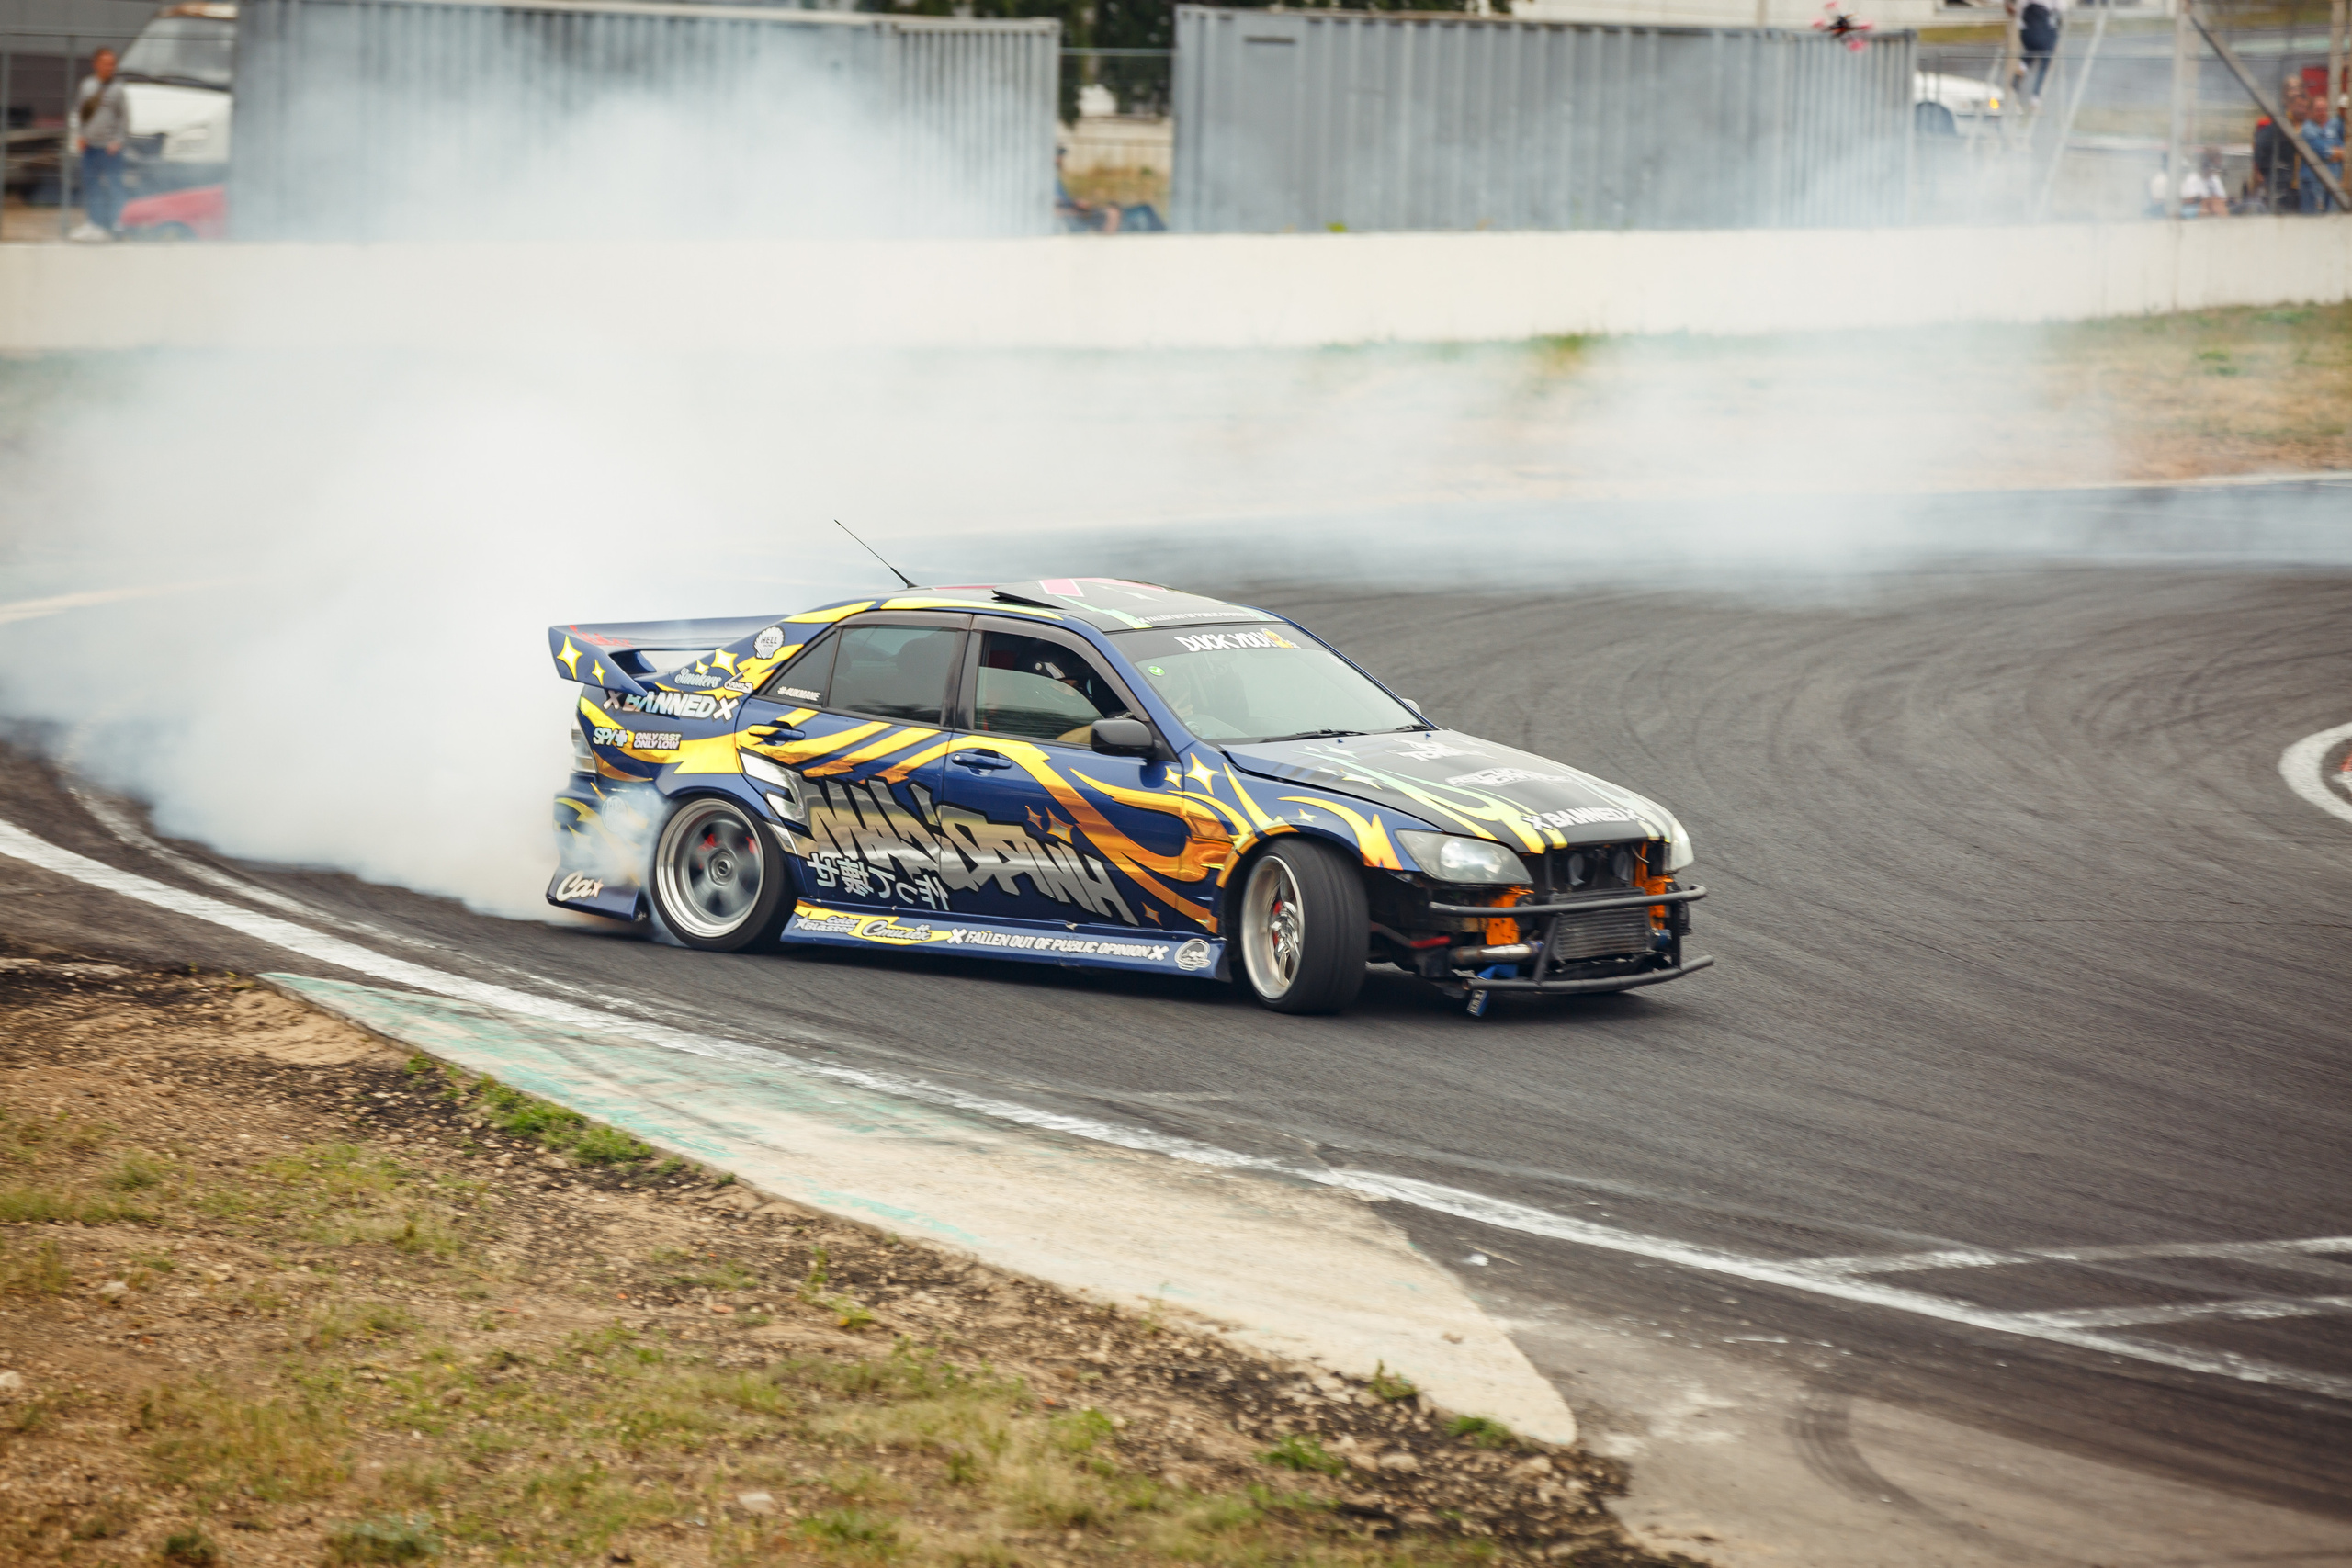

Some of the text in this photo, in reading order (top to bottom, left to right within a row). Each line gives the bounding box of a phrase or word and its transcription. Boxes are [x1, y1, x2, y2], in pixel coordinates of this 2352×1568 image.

[761, 636, 777, 645] HELL
[1174, 634, 1231, 651] DUCK
[674, 667, 722, 688] Smokers
[593, 727, 618, 745] SPY
[635, 732, 681, 741] ONLY FAST
[657, 740, 679, 749] LOW
[1540, 807, 1630, 828] BANNED
[964, 931, 1009, 947] FALLEN
[1009, 935, 1036, 949] OUT
[1034, 937, 1053, 950] OF
[1050, 939, 1099, 953] PUBLIC
[1097, 942, 1150, 958] OPINION
